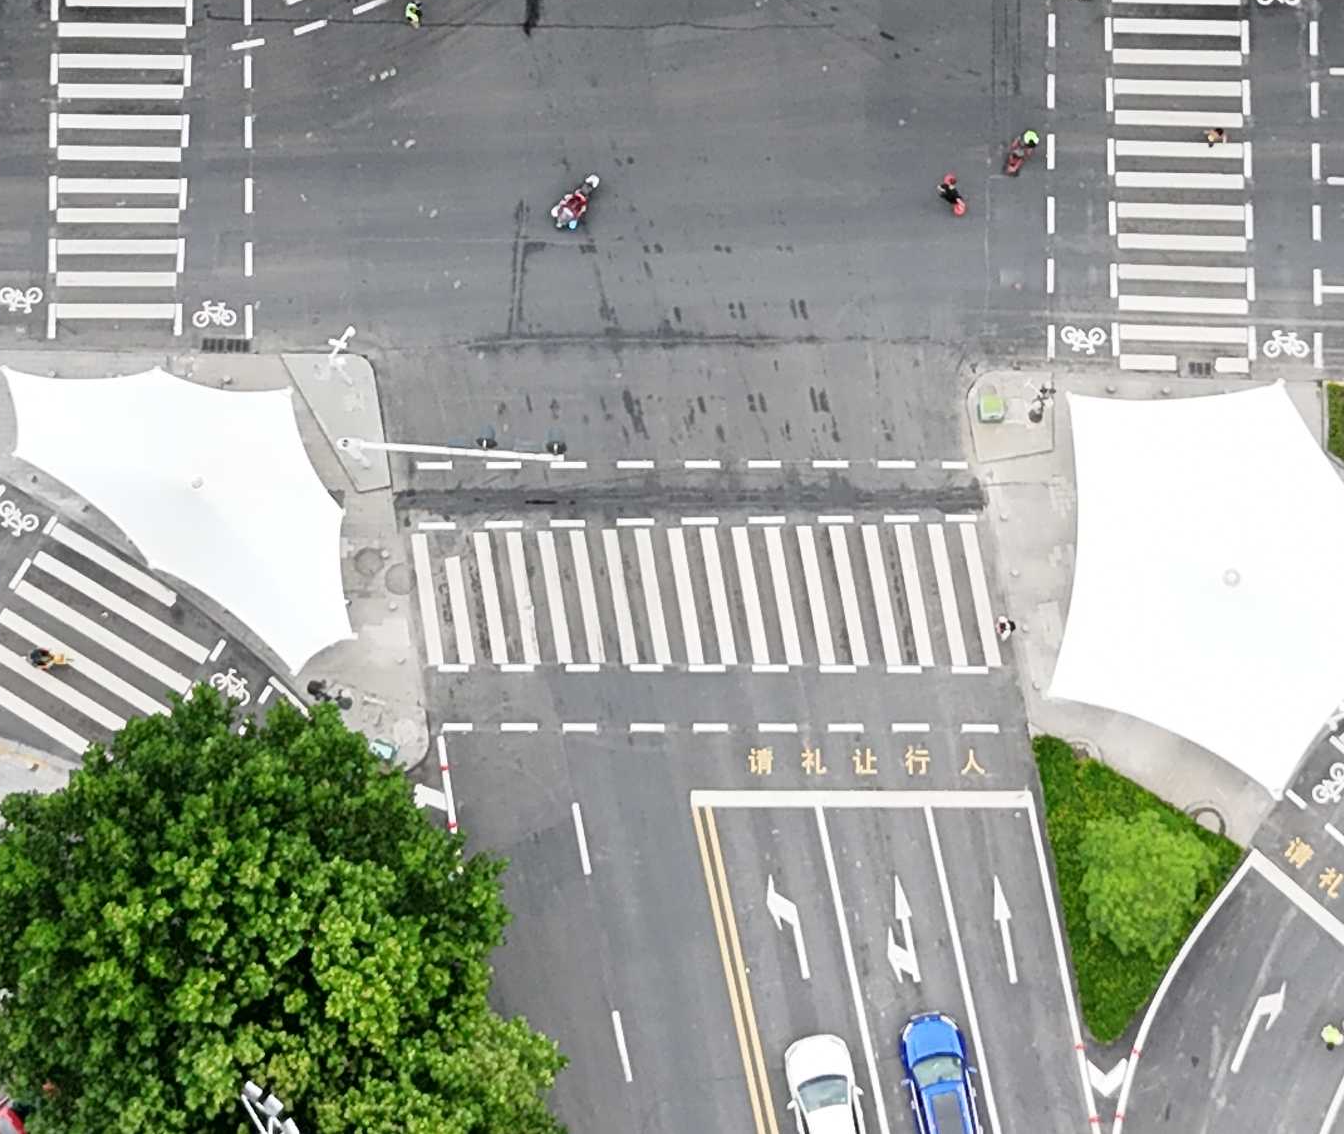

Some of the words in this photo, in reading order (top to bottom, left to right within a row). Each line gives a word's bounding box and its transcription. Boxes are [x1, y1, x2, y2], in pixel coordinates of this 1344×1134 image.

[747, 745, 986, 776] 请礼让行人
